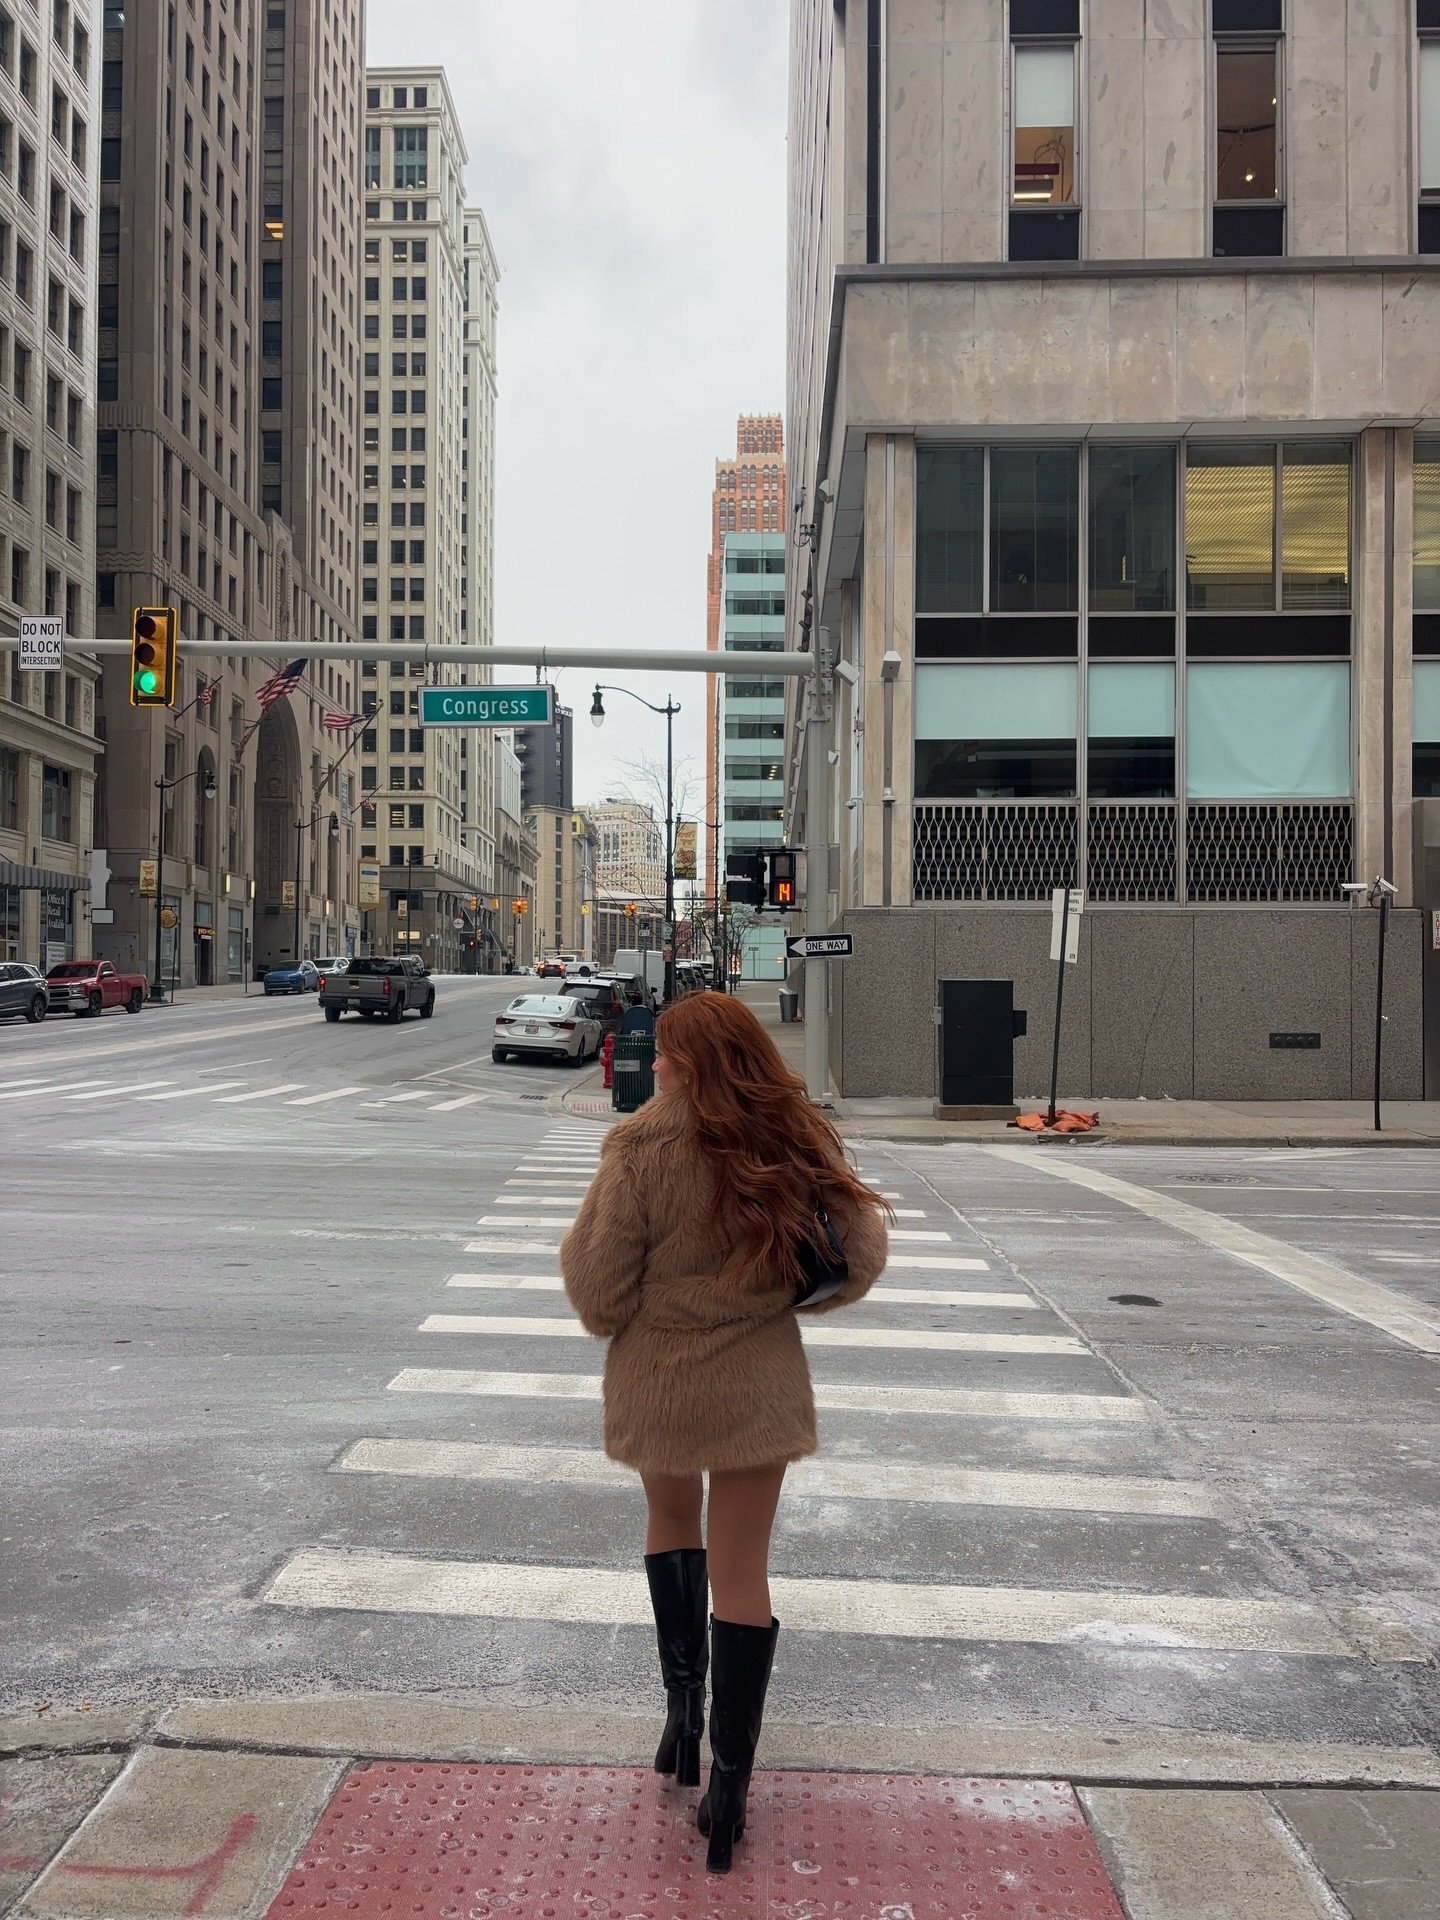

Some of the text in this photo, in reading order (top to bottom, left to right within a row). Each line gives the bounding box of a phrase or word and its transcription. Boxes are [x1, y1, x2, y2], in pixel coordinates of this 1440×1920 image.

[22, 623, 61, 635] DO NOT
[22, 640, 61, 653] BLOCK
[21, 656, 61, 665] INTERSECTION
[443, 698, 528, 719] Congress
[779, 883, 790, 901] 14
[805, 940, 845, 951] ONE WAY
